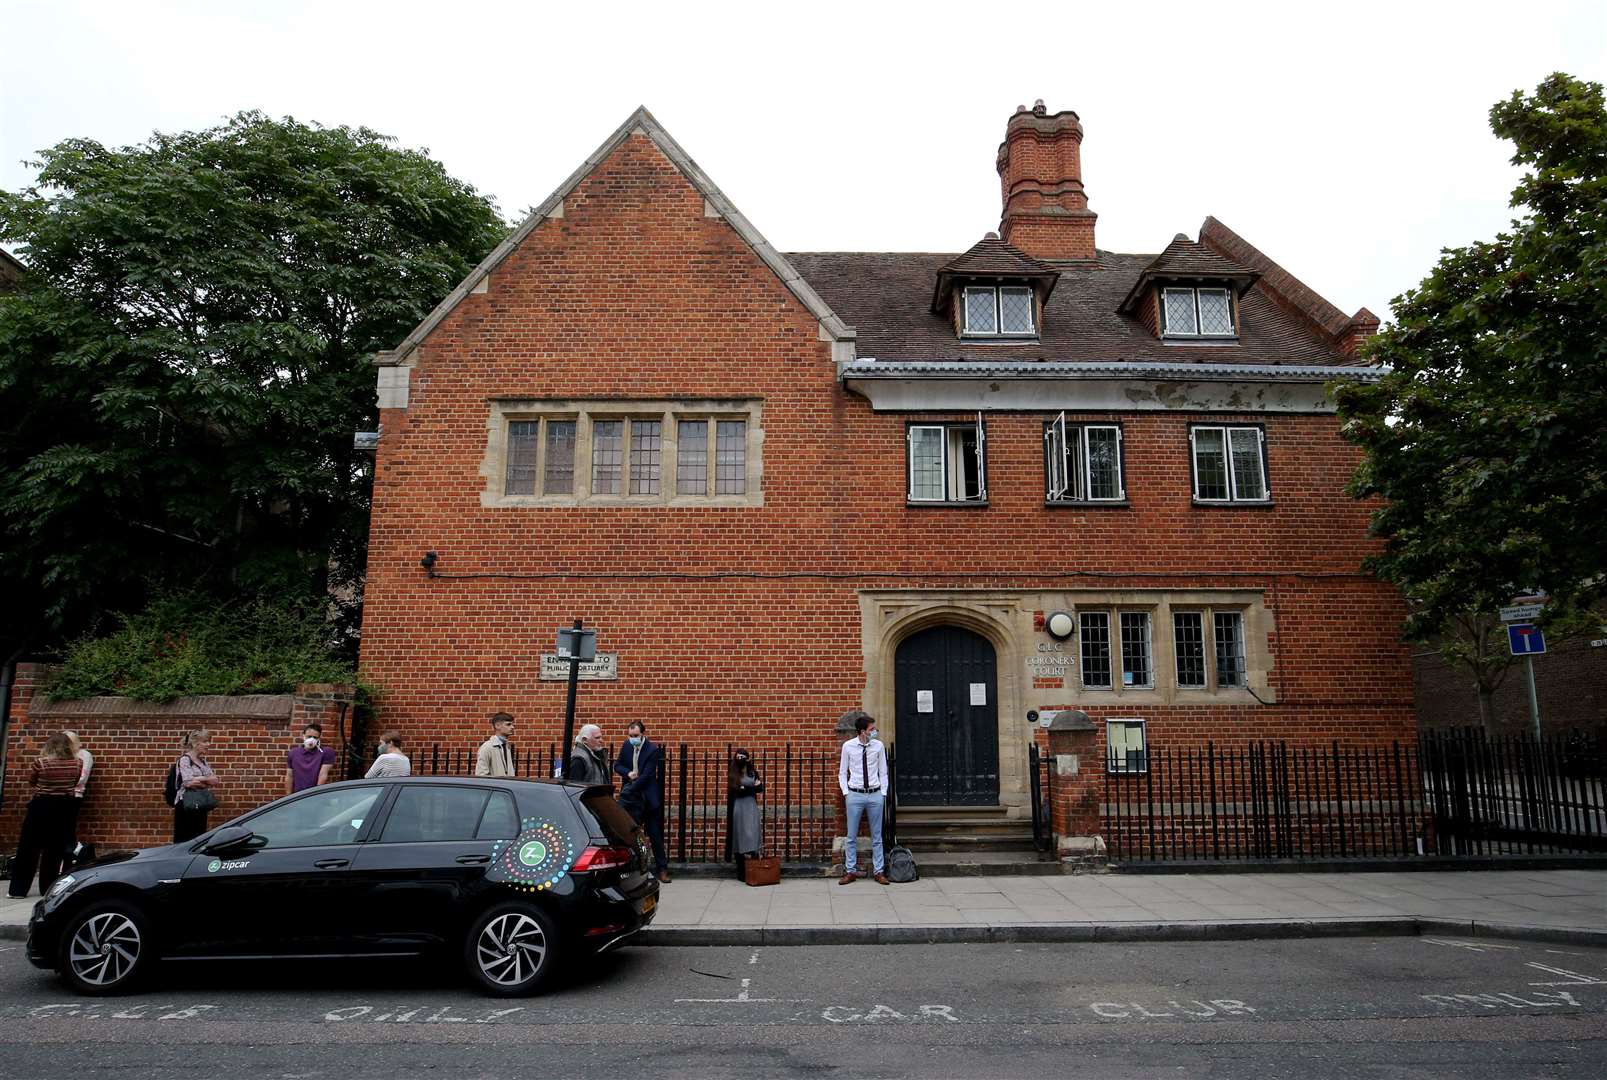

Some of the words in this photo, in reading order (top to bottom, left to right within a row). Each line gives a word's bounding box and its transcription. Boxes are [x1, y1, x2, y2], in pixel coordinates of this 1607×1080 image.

[1034, 667, 1065, 676] COURT
[221, 860, 250, 871] zipcar
[822, 1004, 959, 1022] CAR
